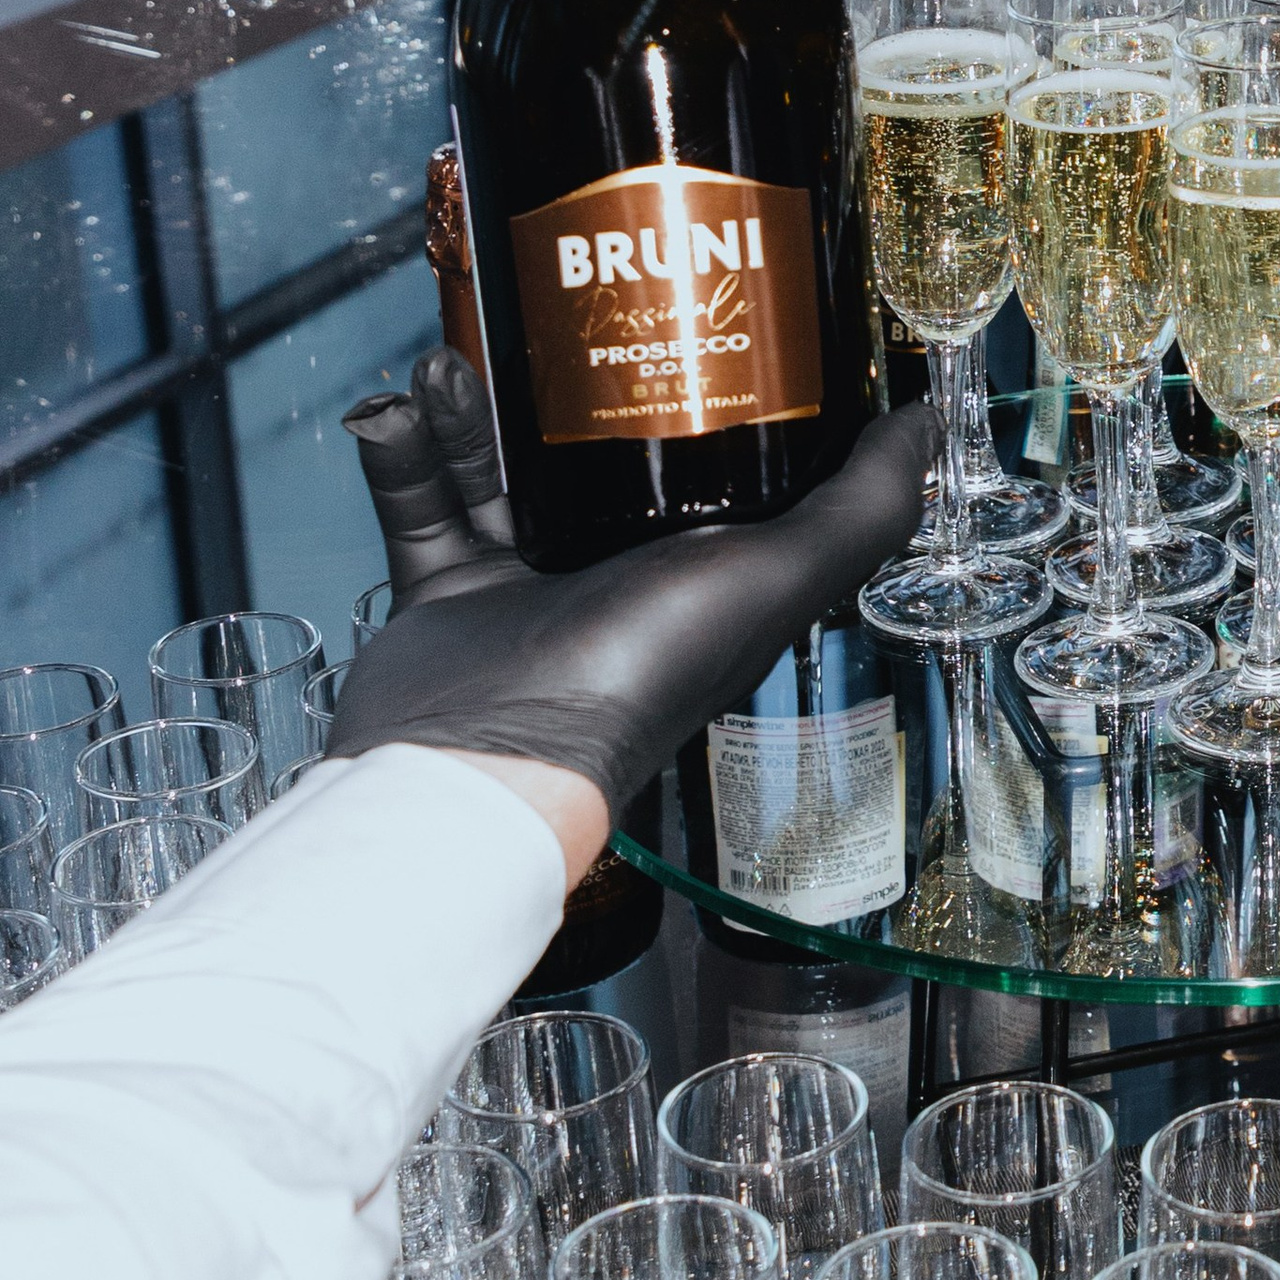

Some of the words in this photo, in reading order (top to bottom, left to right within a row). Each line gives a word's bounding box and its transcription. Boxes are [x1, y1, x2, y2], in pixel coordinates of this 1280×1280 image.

[557, 217, 765, 289] BRUNI
[632, 376, 712, 399] BRUT
[591, 401, 679, 419] PRODOTTO
[705, 393, 759, 410] ITALIA
[727, 715, 785, 731] simplewine
[862, 881, 900, 905] simple
